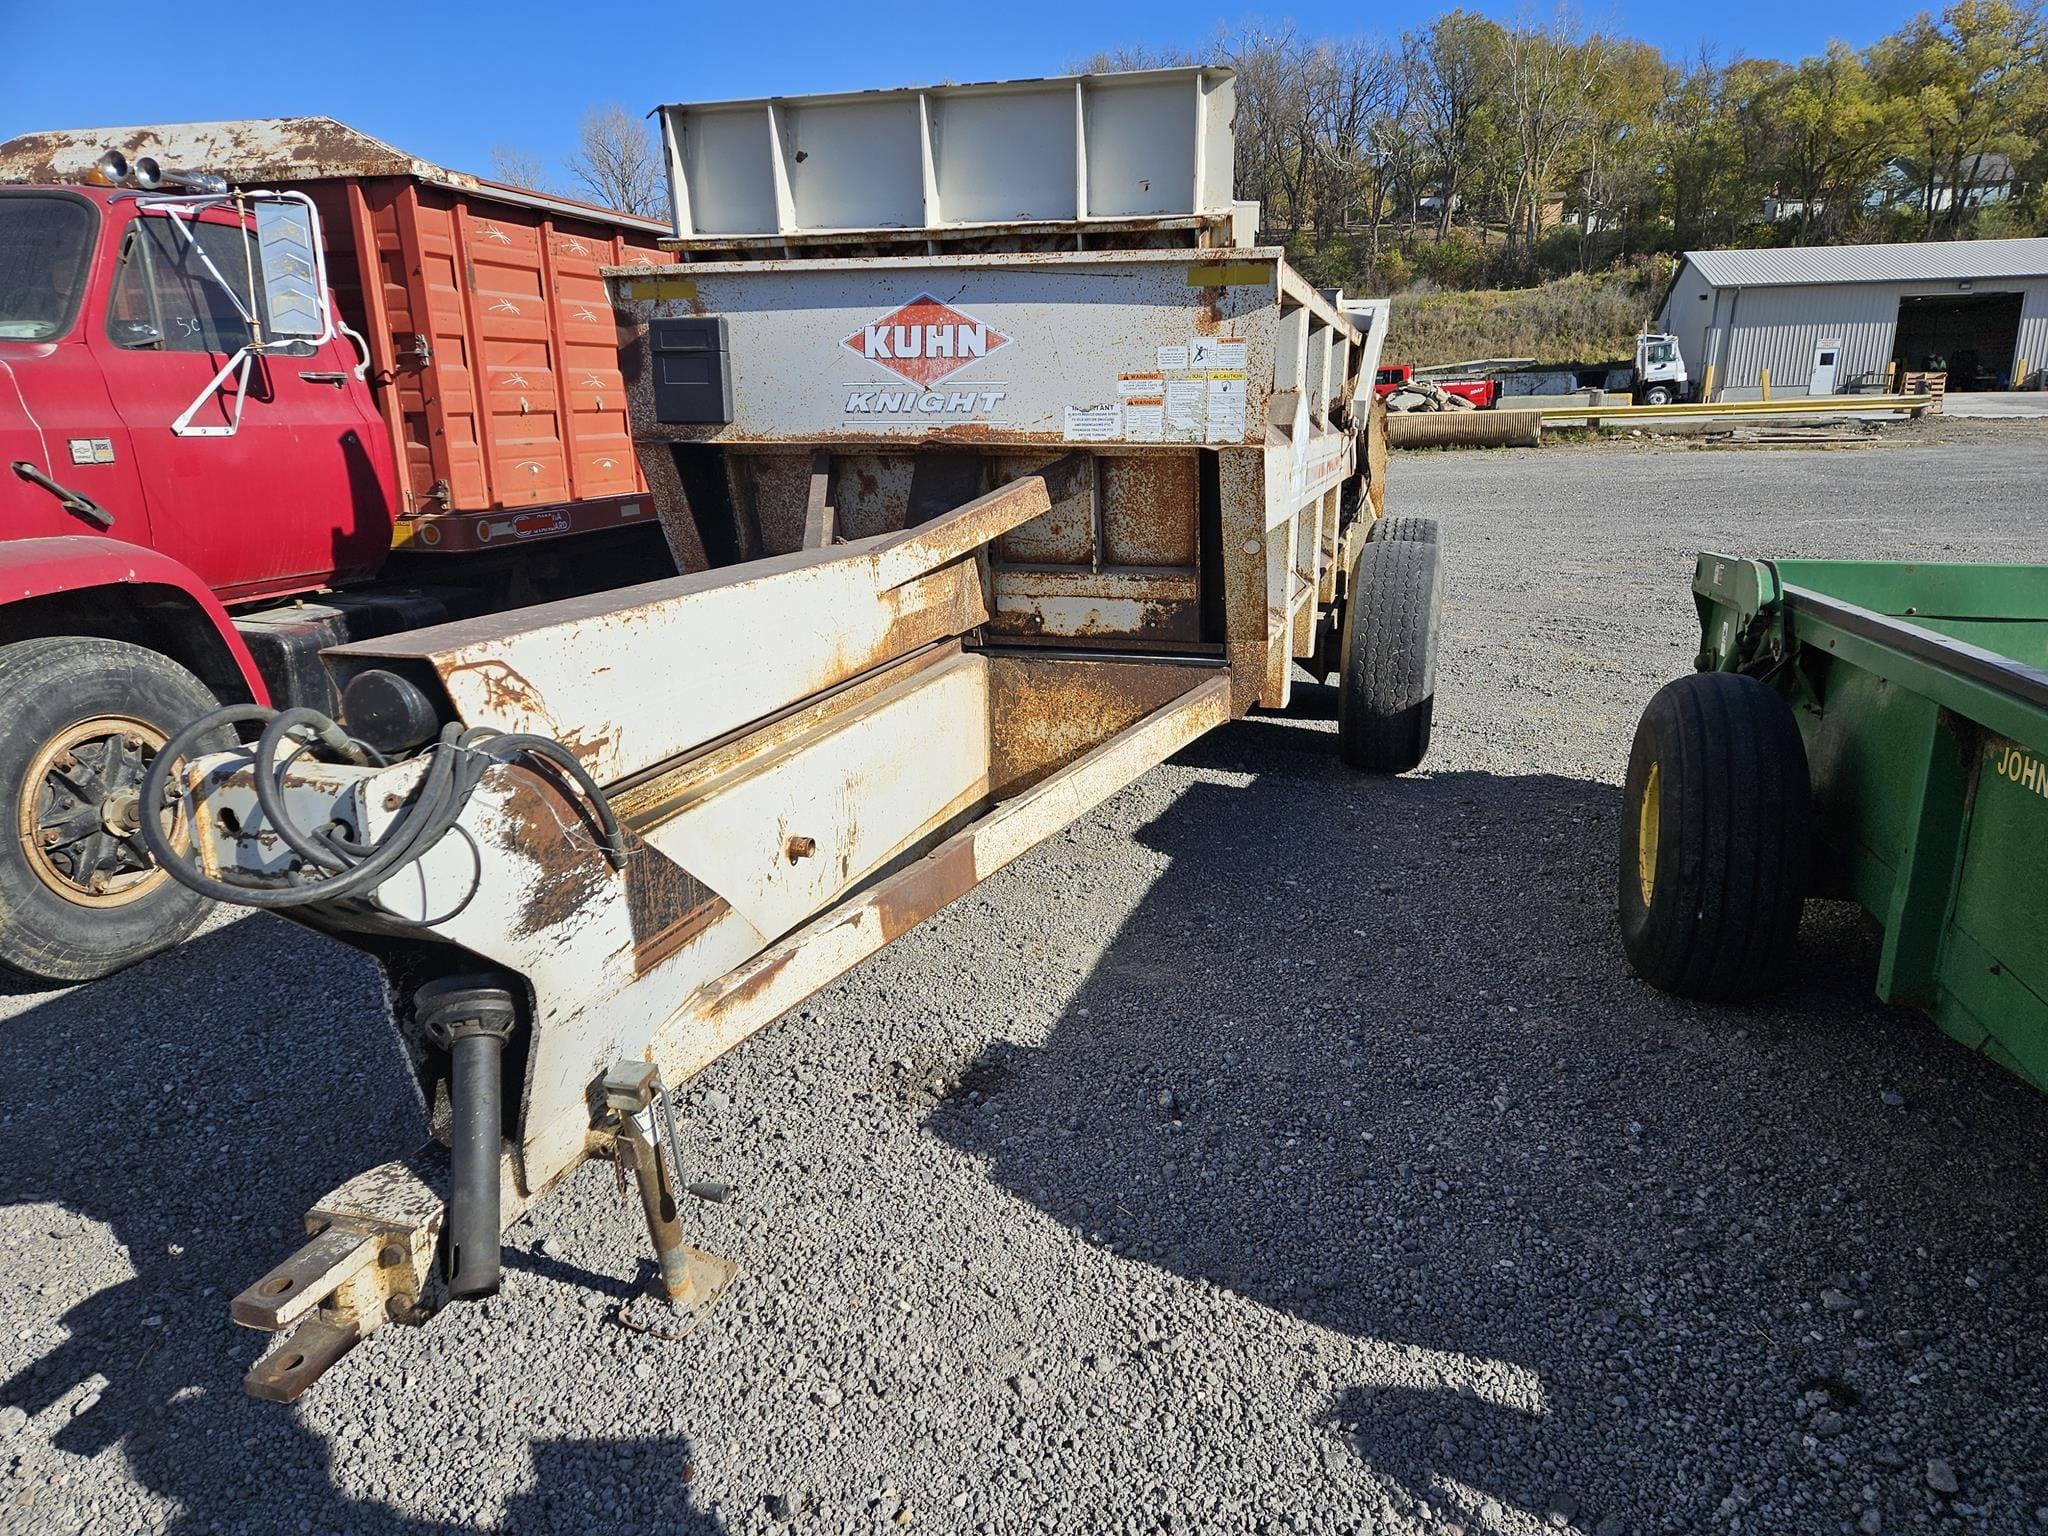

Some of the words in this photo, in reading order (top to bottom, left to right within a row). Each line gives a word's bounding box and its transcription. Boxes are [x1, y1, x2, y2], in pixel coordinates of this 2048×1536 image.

[864, 324, 987, 359] KUHN
[845, 392, 1006, 413] KNIGHT
[1998, 747, 2048, 798] JOHN
